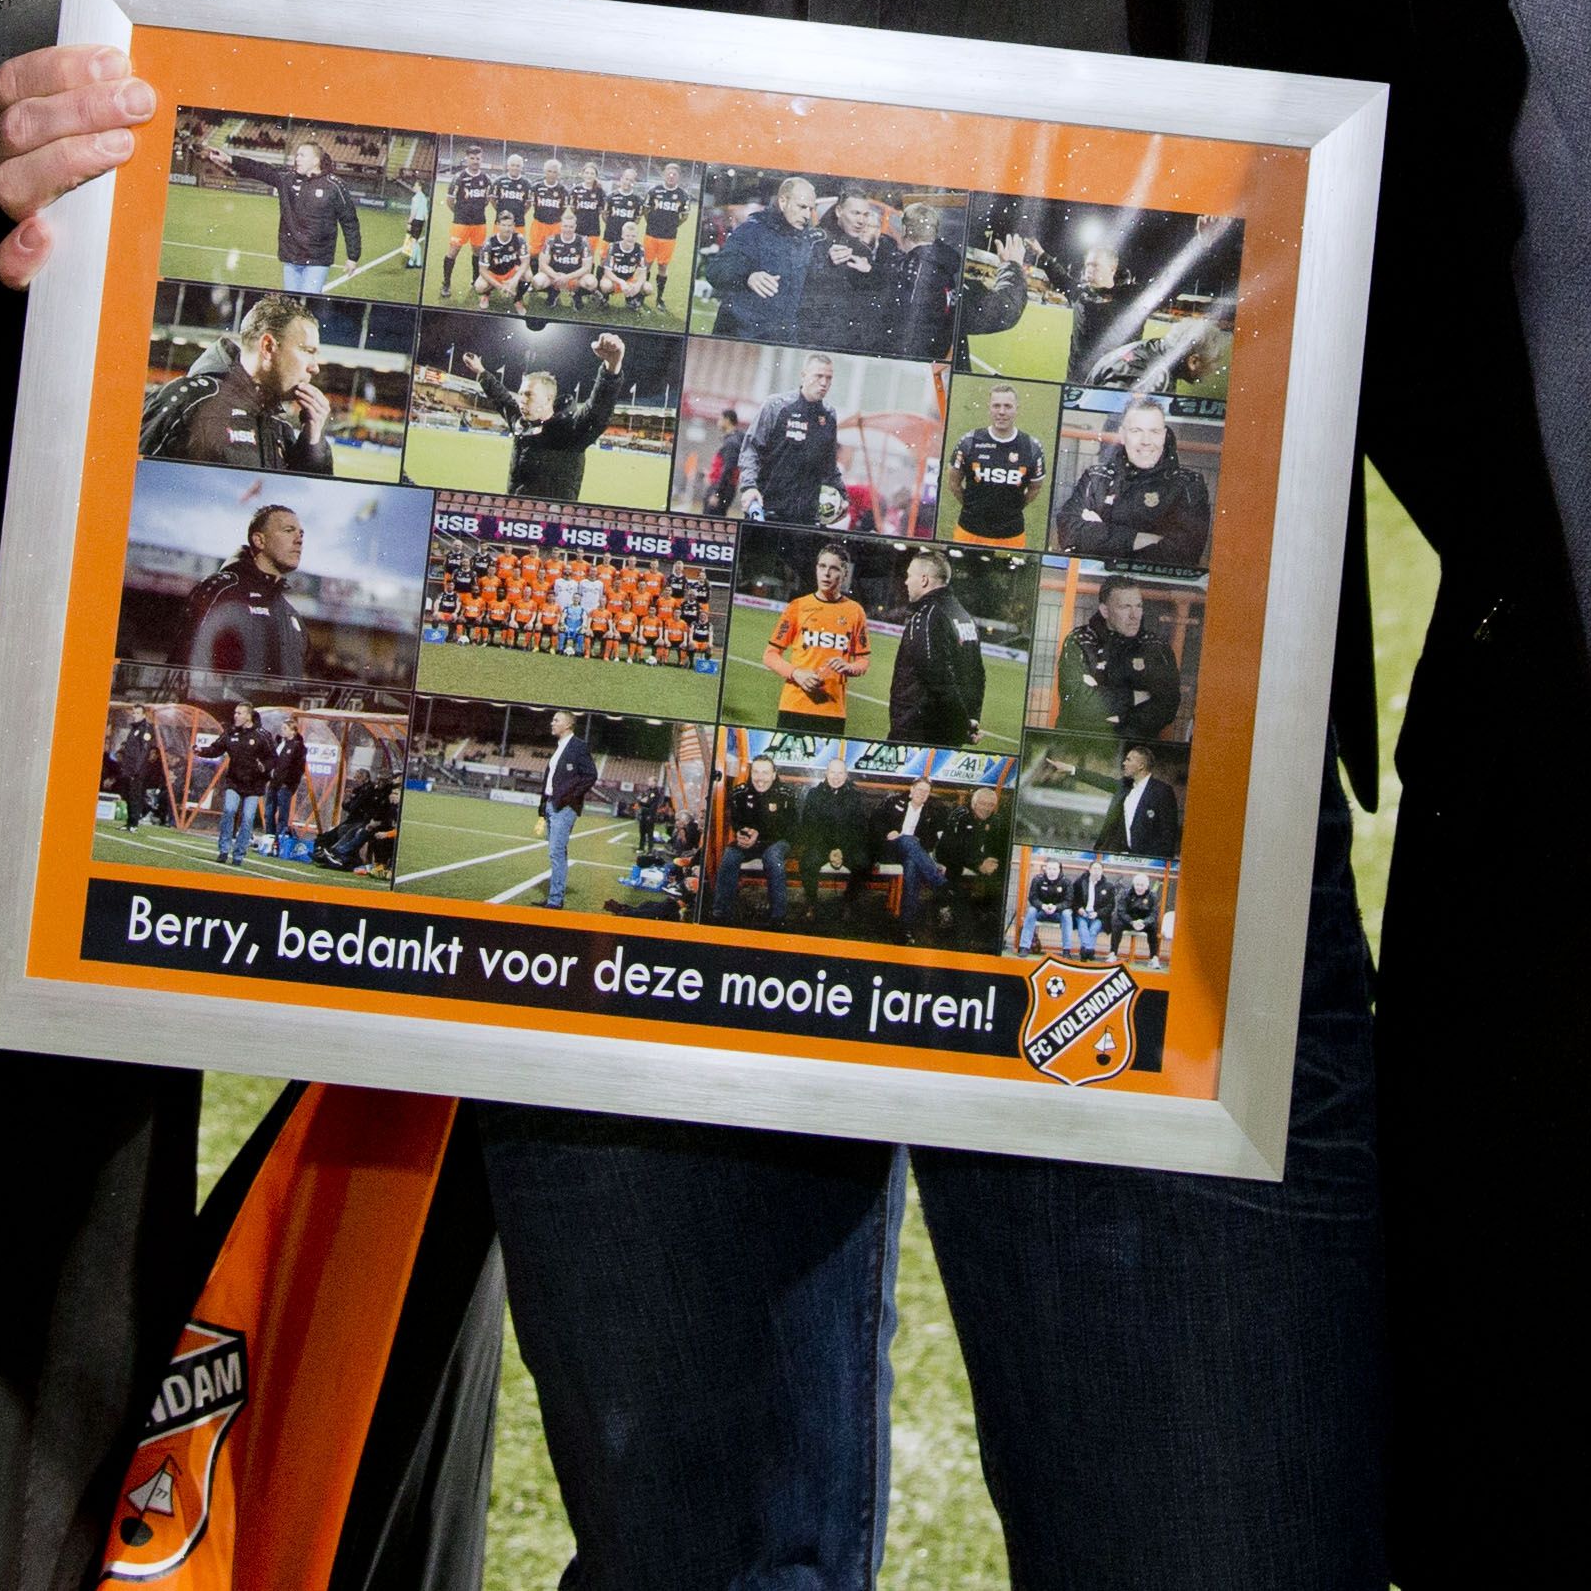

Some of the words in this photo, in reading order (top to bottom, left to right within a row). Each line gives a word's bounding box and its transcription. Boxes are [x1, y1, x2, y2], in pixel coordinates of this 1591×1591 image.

[974, 467, 1024, 485] HSB
[434, 512, 480, 534] HSB
[498, 520, 545, 541] HSB
[562, 527, 609, 549] HSB
[626, 534, 672, 556] HSB
[690, 542, 735, 563] HSB
[802, 629, 850, 652] HSB
[127, 894, 260, 966] Berry,
[276, 910, 464, 976] bedankt
[478, 946, 579, 989] voor
[594, 945, 704, 1002] deze
[719, 969, 853, 1018] mooie
[867, 975, 997, 1034] jaren!
[1028, 1037, 1054, 1065] FC
[1048, 970, 1134, 1045] VOLENDAM
[145, 1351, 243, 1428] DAM
